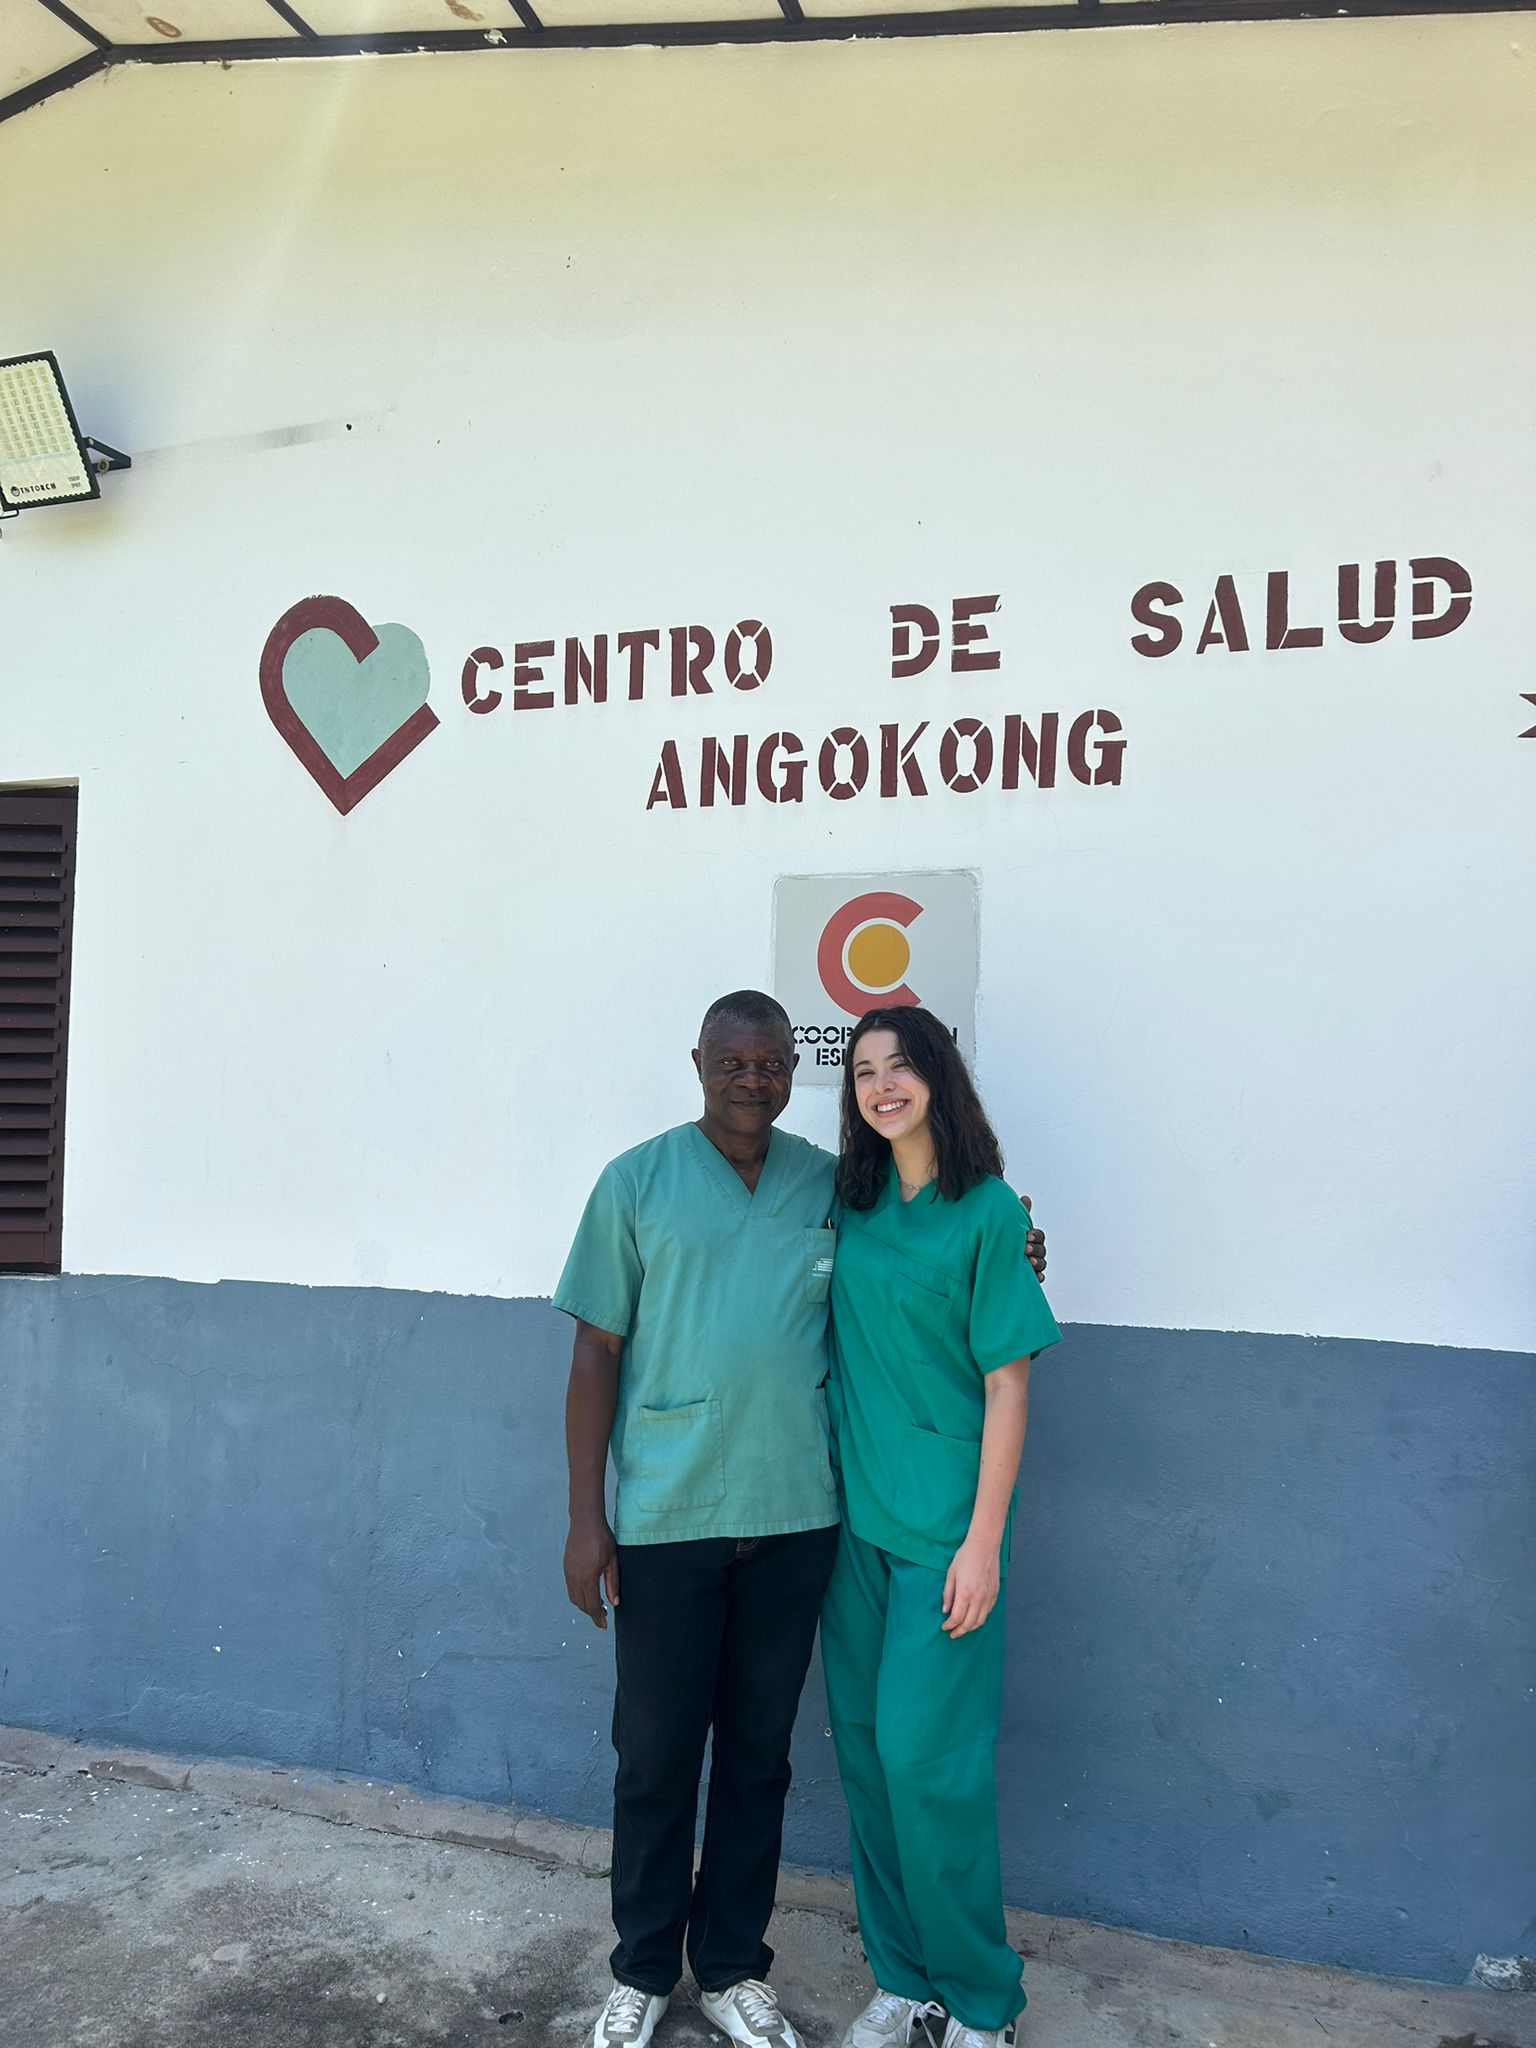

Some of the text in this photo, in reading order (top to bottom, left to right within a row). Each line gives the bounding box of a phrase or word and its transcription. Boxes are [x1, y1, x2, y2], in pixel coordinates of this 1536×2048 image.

[462, 556, 1473, 715] CENTRO DE SALUD
[646, 709, 1128, 811] ANGOKONG
